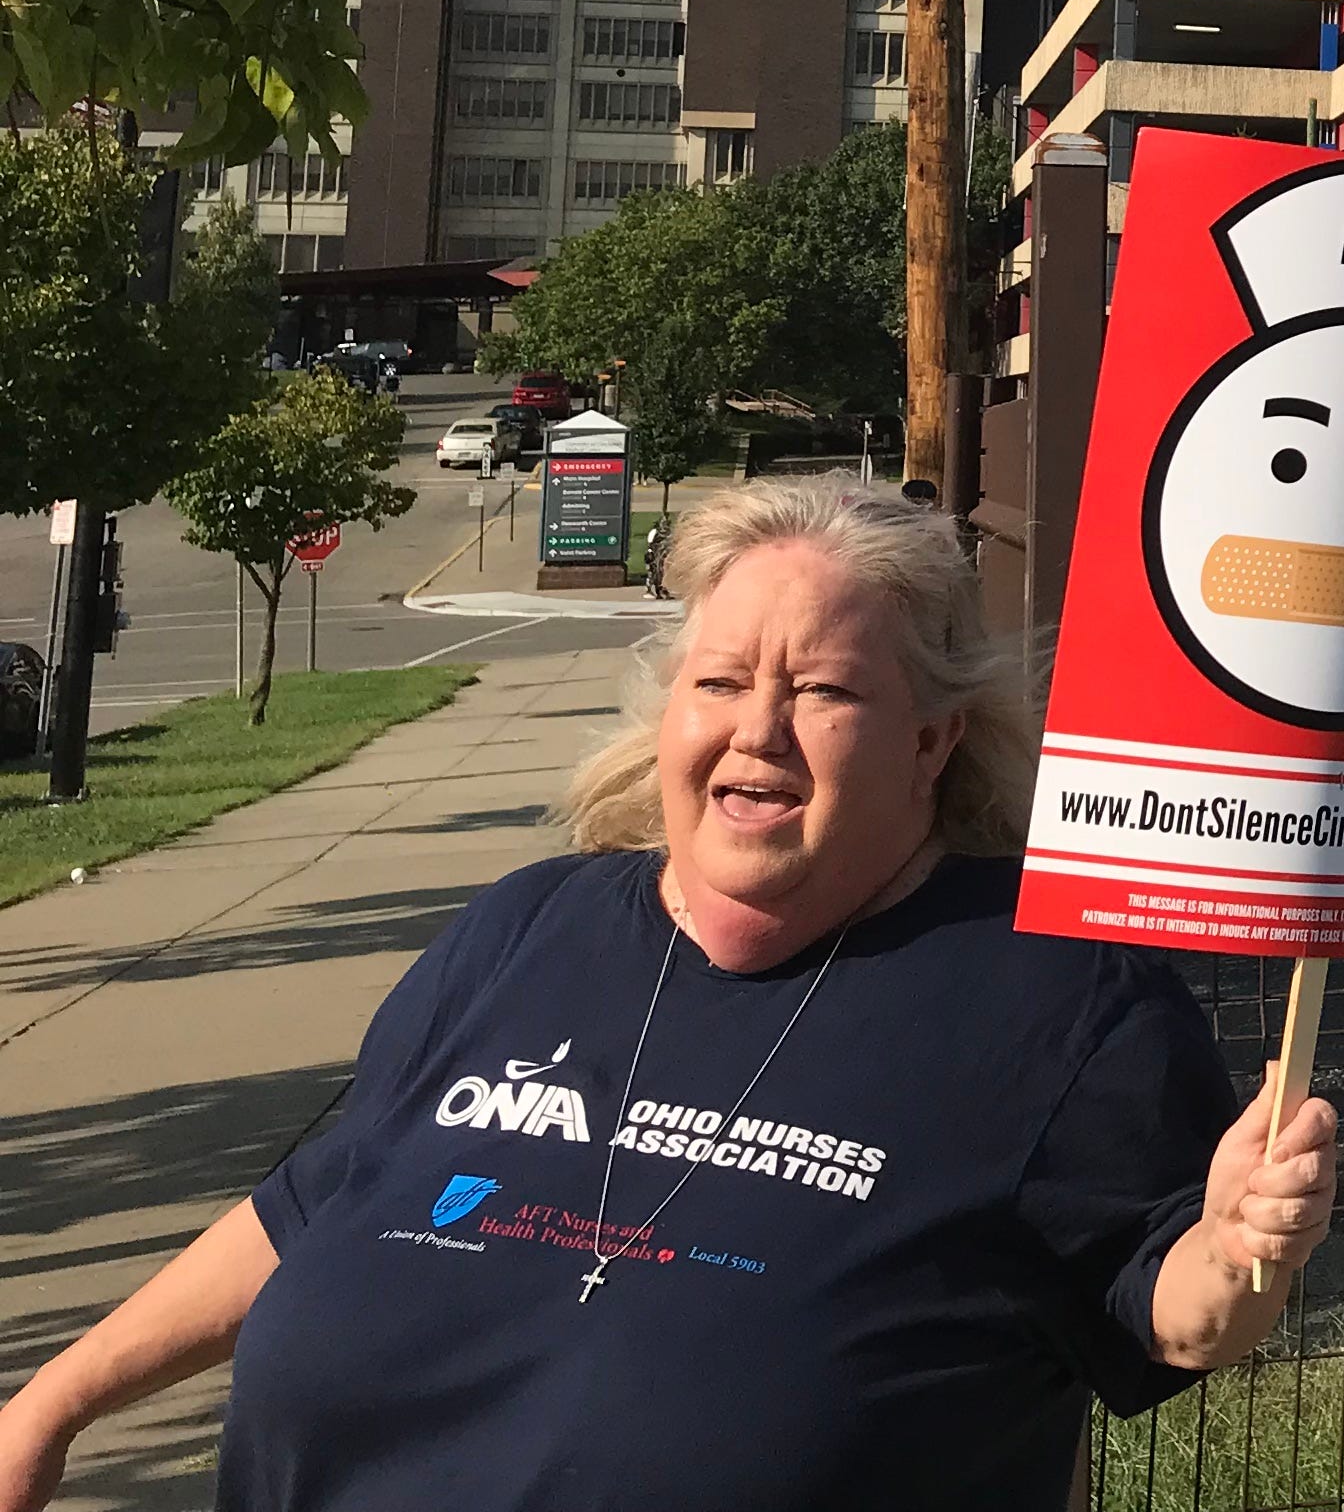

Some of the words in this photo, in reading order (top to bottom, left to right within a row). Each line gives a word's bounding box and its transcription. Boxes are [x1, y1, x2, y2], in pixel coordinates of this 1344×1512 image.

[1128, 894, 1147, 908] THIS
[1148, 896, 1186, 912] MESSAGE
[1188, 900, 1196, 913] IS
[1198, 901, 1213, 914] FOR
[1215, 902, 1279, 919] INFORMATIONAL
[1281, 908, 1320, 922] PURPOSES
[1082, 909, 1126, 927] PATRONIZE
[1128, 914, 1146, 928] NOR
[1146, 916, 1155, 930] IS
[1156, 917, 1165, 931] IT
[1166, 918, 1207, 935] INTENDED
[1208, 922, 1218, 936] TO
[1219, 924, 1249, 939] INDUCE
[1251, 926, 1269, 940] ANY
[1269, 928, 1309, 942] EMPLOYEE
[1310, 929, 1319, 942] TO
[436, 1076, 590, 1142] ONA
[628, 1099, 722, 1136] OHIO
[728, 1101, 886, 1173] NURSES
[609, 1125, 874, 1201] ASSOCIATION
[479, 1216, 535, 1240] Health
[514, 1203, 557, 1223] AFT
[558, 1210, 617, 1237] Nurses
[618, 1223, 655, 1241] and
[414, 1231, 429, 1245] of
[425, 1232, 486, 1253] Professionals
[688, 1246, 728, 1266] Local
[728, 1256, 767, 1275] 5903
